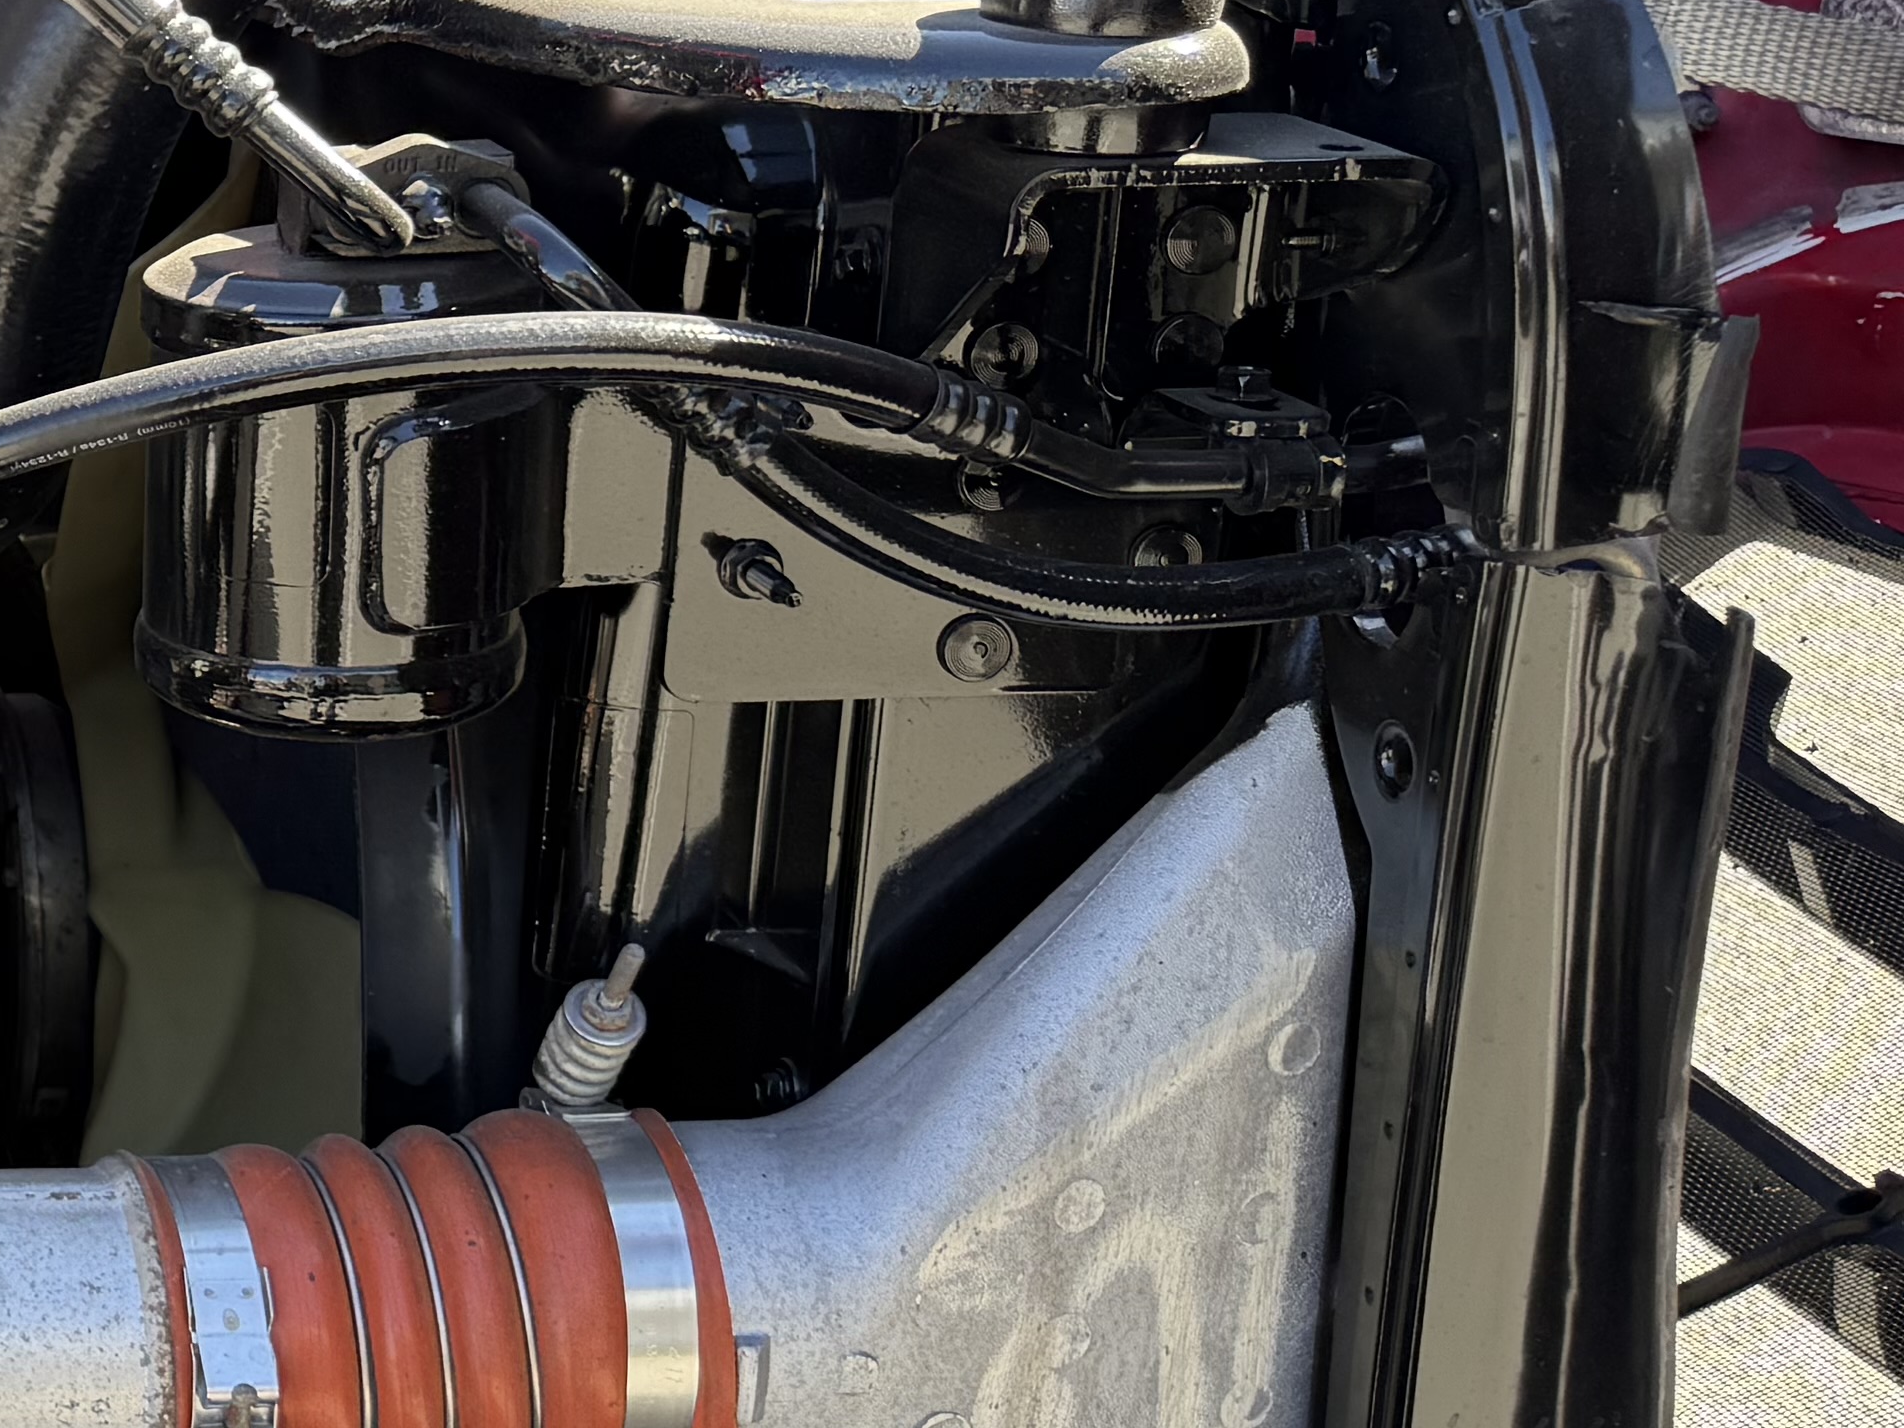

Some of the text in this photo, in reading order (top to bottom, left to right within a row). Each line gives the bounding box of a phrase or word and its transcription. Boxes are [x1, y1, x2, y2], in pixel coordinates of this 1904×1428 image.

[385, 153, 458, 173] OUT IN
[136, 417, 193, 436] (10mm)
[80, 432, 129, 450] R-134a
